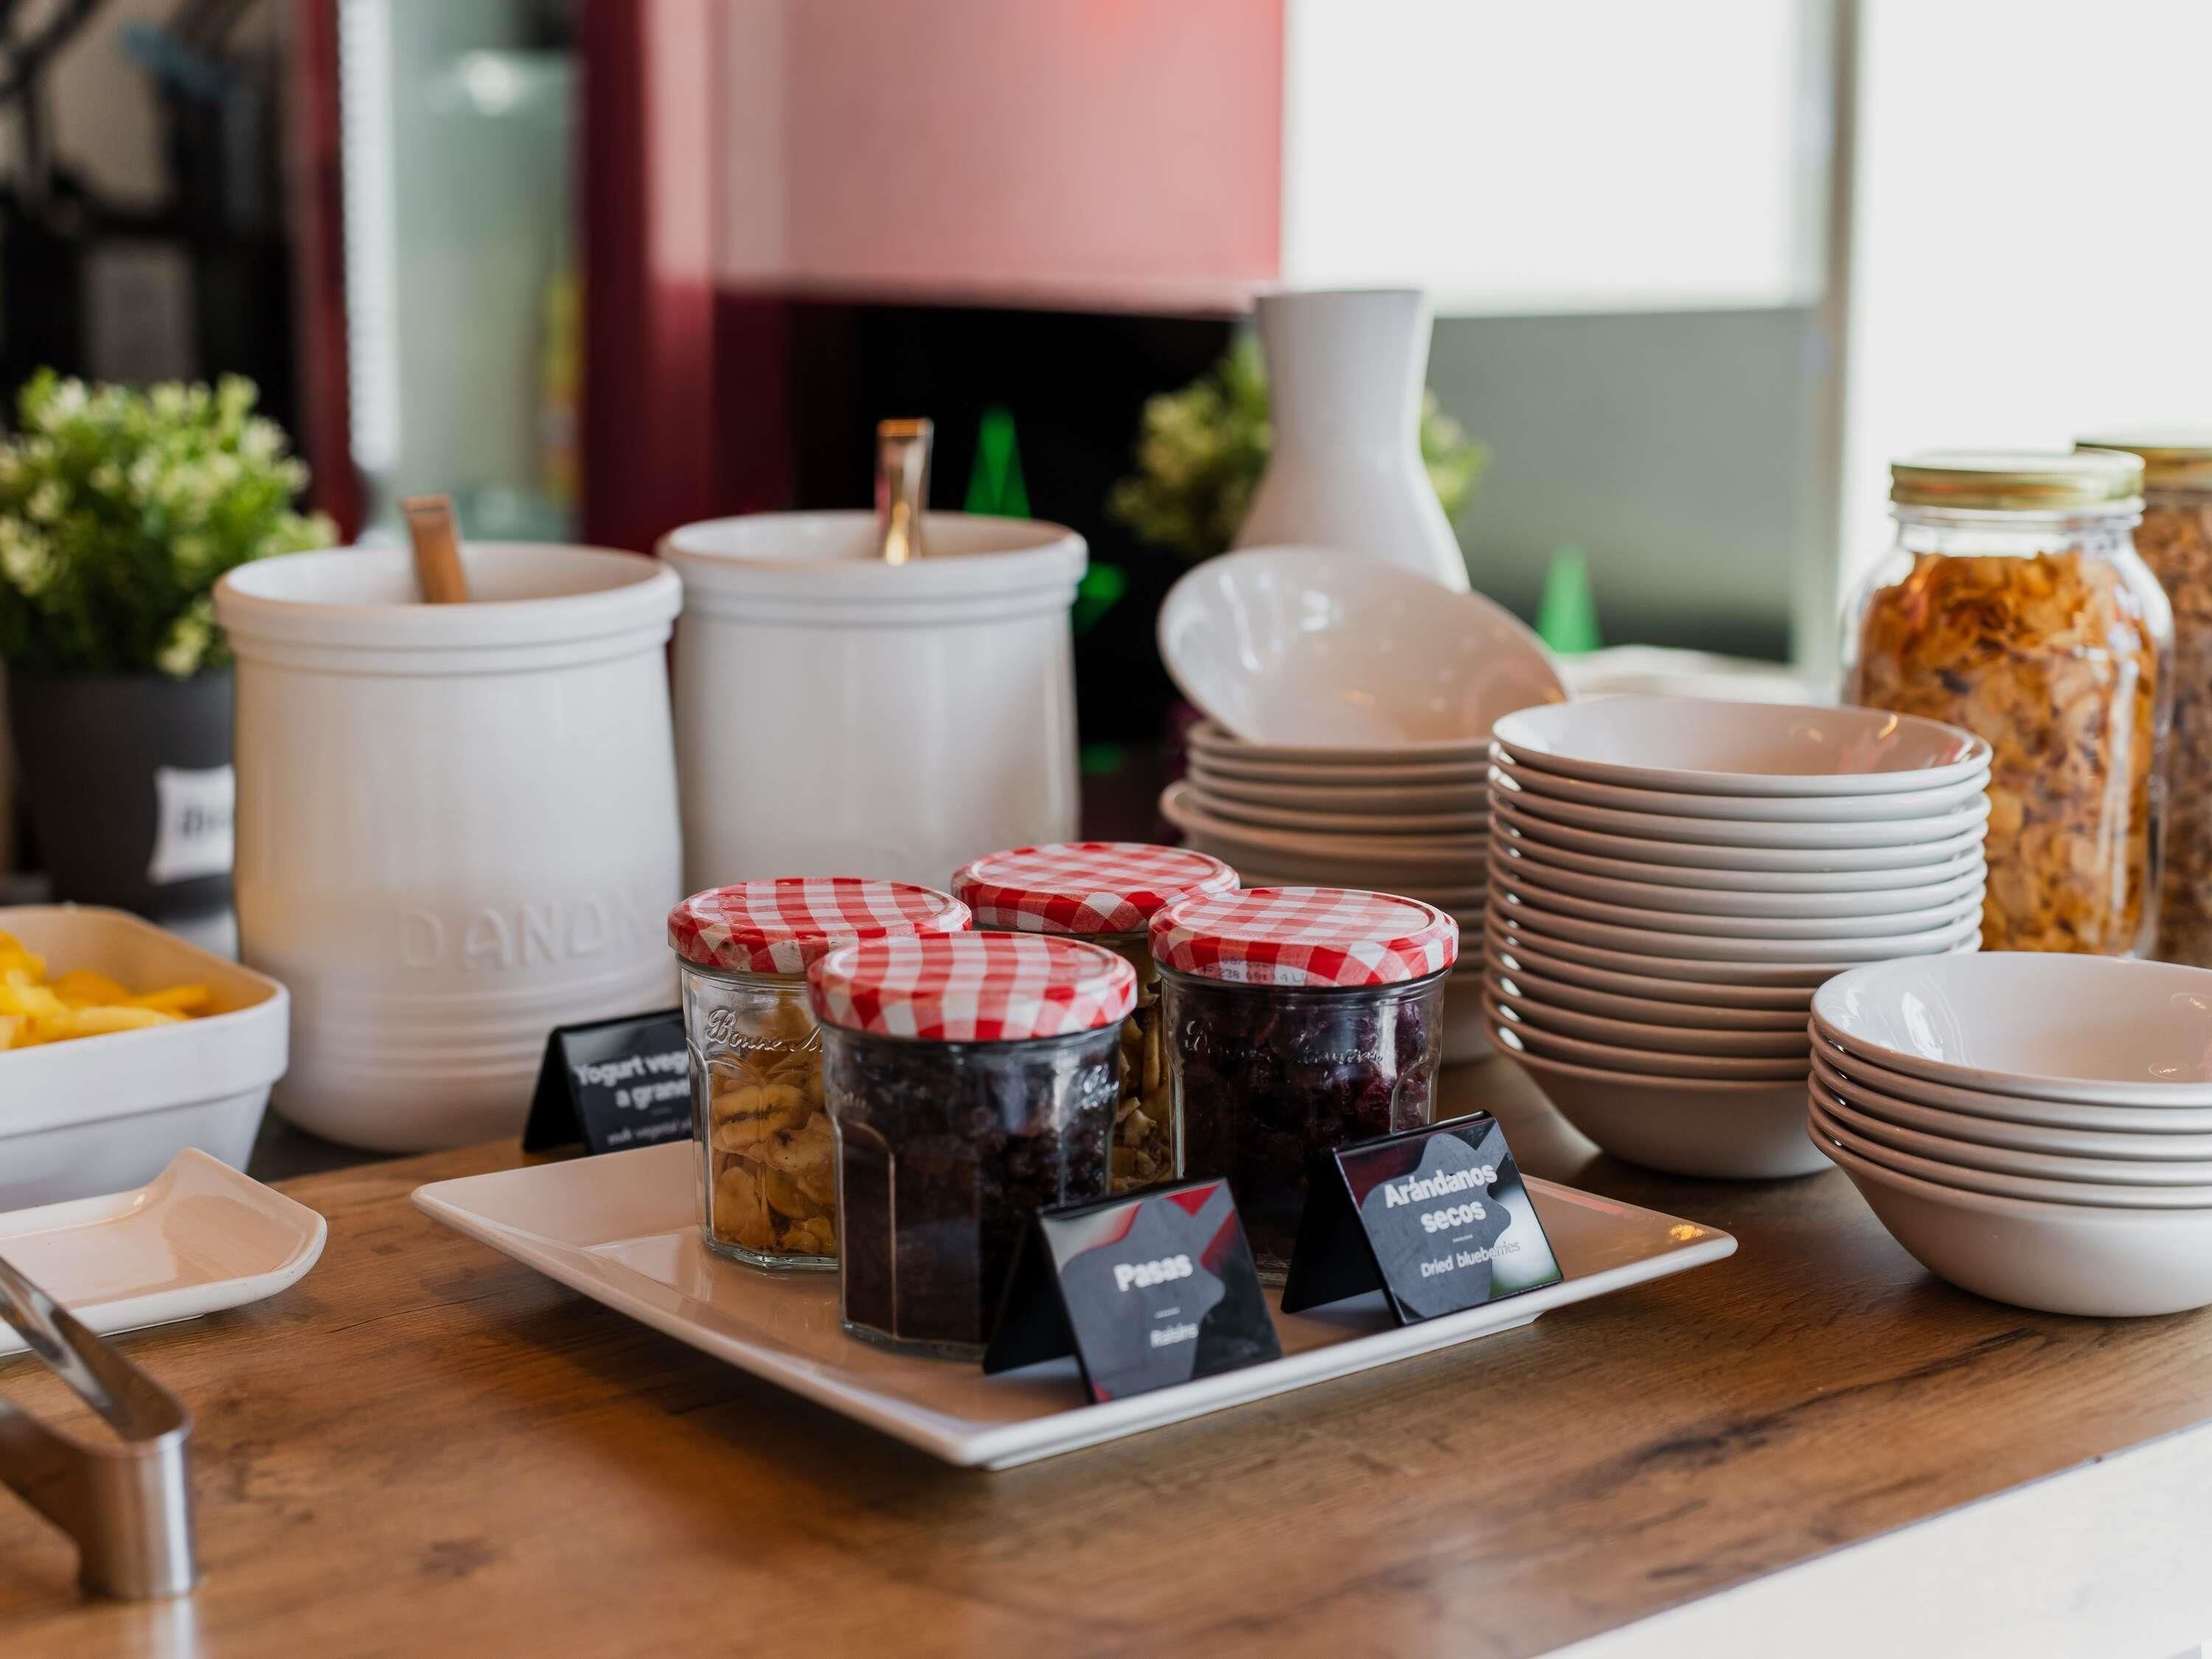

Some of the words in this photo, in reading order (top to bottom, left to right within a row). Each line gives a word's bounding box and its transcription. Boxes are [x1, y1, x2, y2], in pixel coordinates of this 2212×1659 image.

[1384, 1164, 1498, 1208] Arándanos
[1420, 1201, 1486, 1234] secos
[1113, 1253, 1194, 1292] Pasas
[1420, 1254, 1454, 1279] Dried
[1456, 1241, 1521, 1268] blueberries
